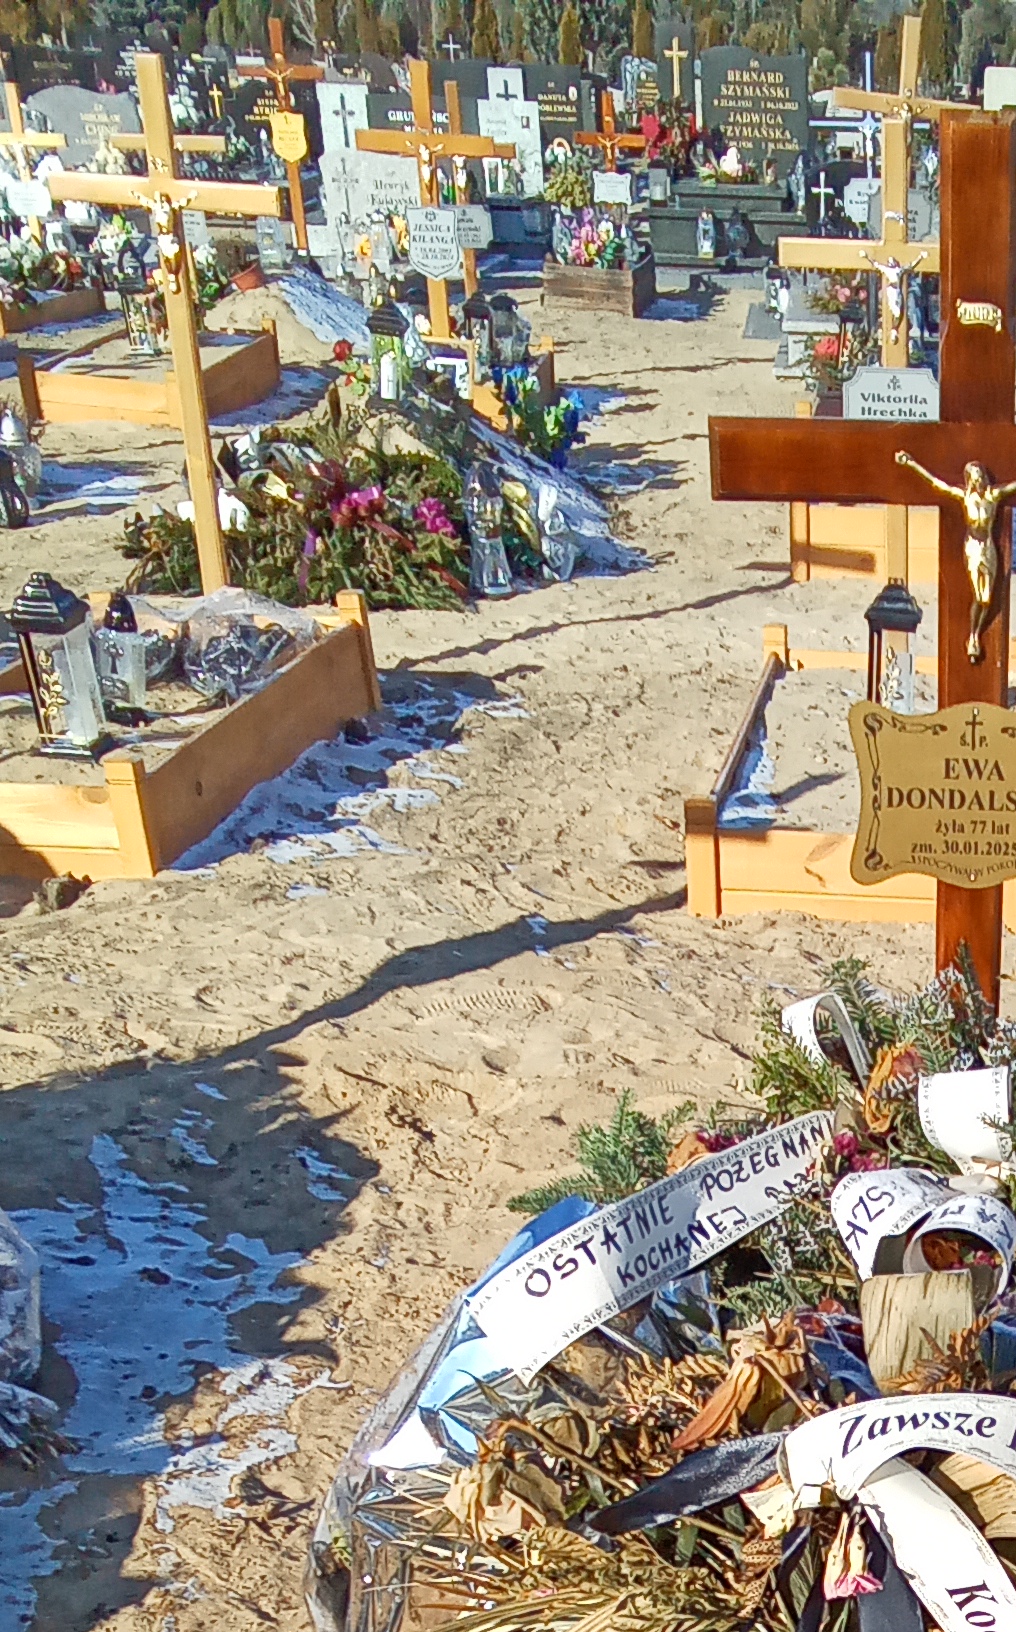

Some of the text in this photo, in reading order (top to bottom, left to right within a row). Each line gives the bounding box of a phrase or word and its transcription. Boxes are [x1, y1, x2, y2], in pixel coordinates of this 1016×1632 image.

[727, 69, 784, 84] BERNARD
[720, 83, 790, 99] SZYMAŃSKI
[728, 111, 783, 126] JADWIGA
[413, 223, 451, 233] JESSICA
[860, 406, 928, 418] Hrechka
[943, 757, 1006, 782] EWA
[935, 819, 1011, 836] żyła 77 lat
[911, 842, 937, 854] zm.
[523, 1196, 675, 1299] OSTATNIE
[615, 1204, 748, 1288] KOCHANEJ
[838, 1410, 998, 1461] Zawsze
